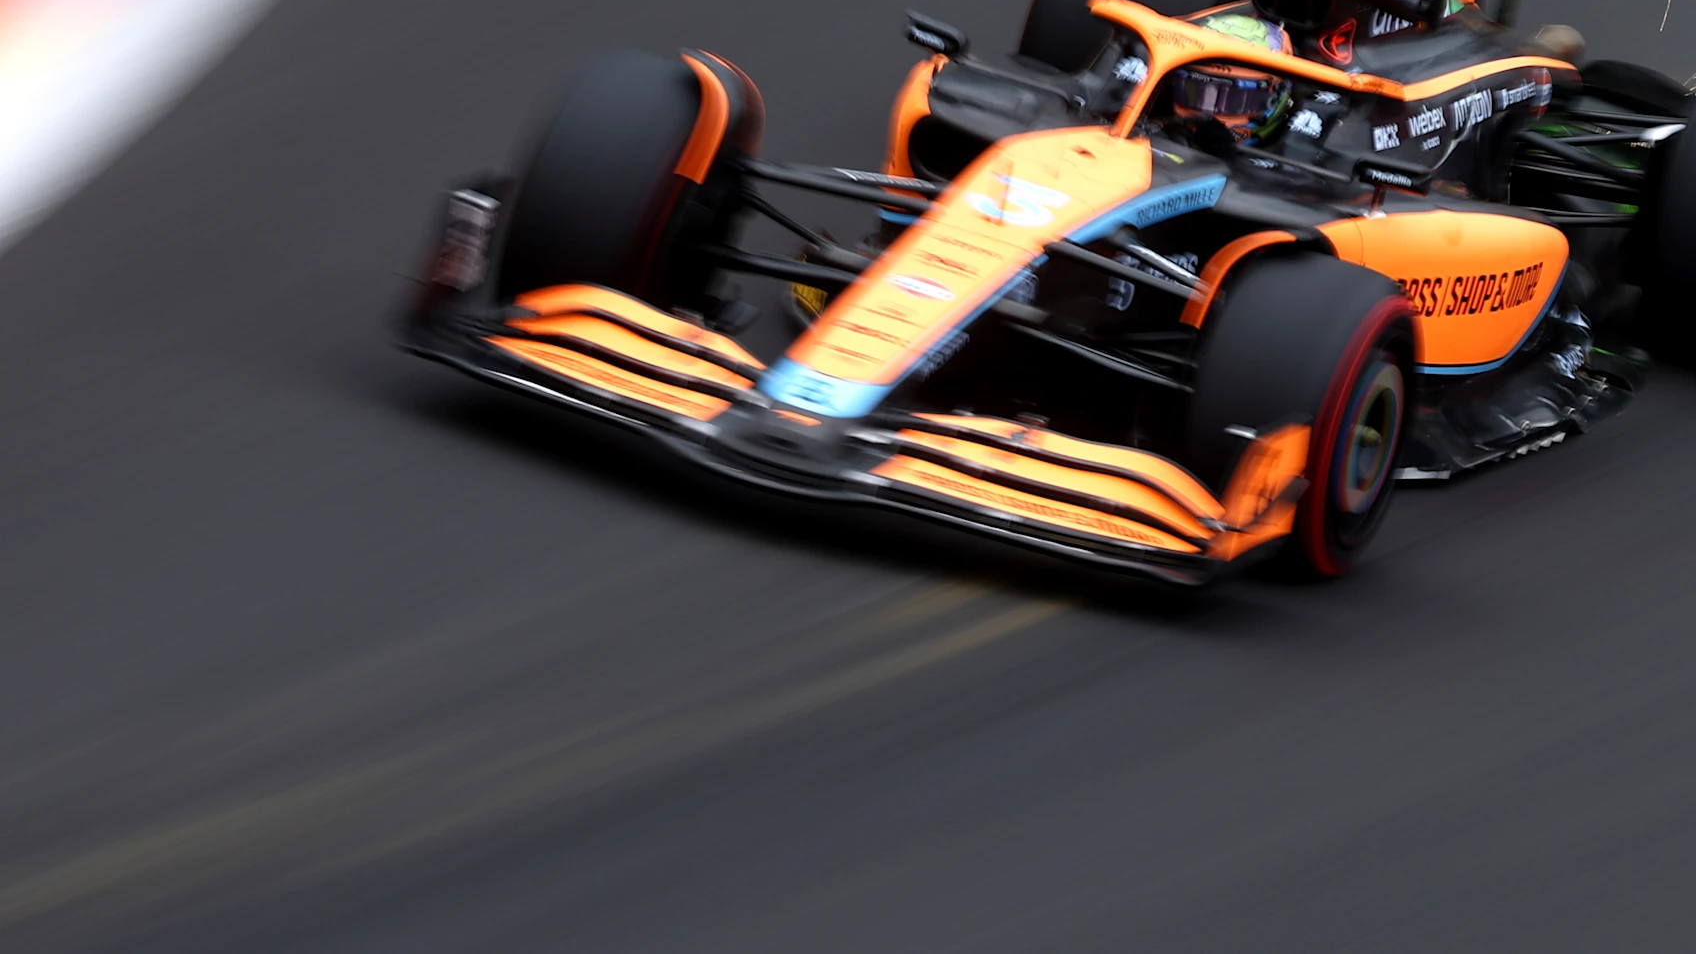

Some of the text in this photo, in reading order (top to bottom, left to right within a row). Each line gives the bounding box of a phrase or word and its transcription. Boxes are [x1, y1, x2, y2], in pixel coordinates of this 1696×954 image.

[1407, 104, 1447, 138] webex
[1371, 170, 1412, 188] Medallia
[1136, 187, 1216, 225] RICHARD MILLE
